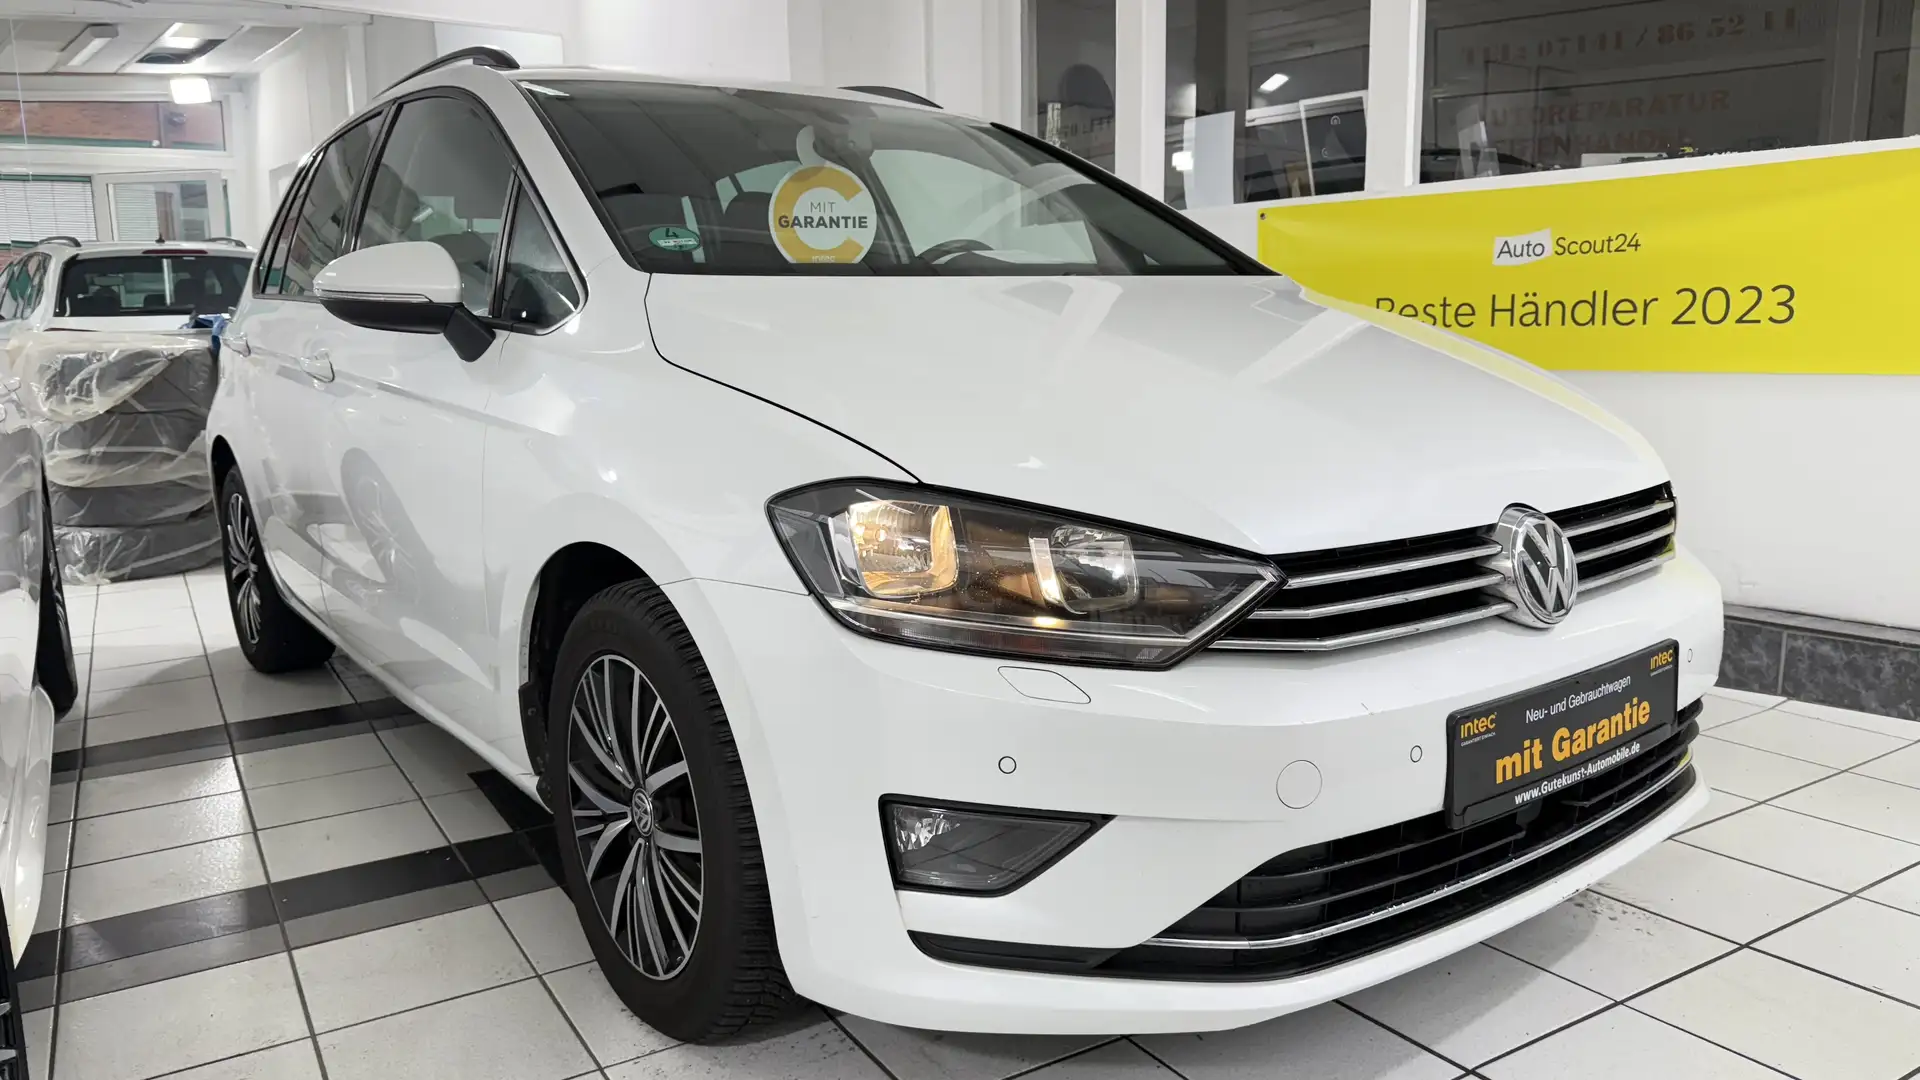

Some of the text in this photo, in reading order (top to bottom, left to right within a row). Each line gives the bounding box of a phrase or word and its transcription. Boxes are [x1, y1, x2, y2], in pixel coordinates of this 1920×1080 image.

[1656, 22, 1696, 44] 86
[1705, 14, 1746, 38] 52
[1489, 89, 1731, 127] UTOREPARATUR
[778, 214, 868, 229] GARANTIE
[809, 201, 836, 213] MIT
[1497, 232, 1641, 259] Auto Scout24
[1490, 289, 1659, 328] Händler
[1671, 284, 1795, 325] 2023
[1525, 675, 1631, 723] Neu- und Gebrauchtwagen
[1495, 696, 1650, 785] mit Garantie
[1514, 741, 1641, 805] www.Gutekunst-Automobile.de
